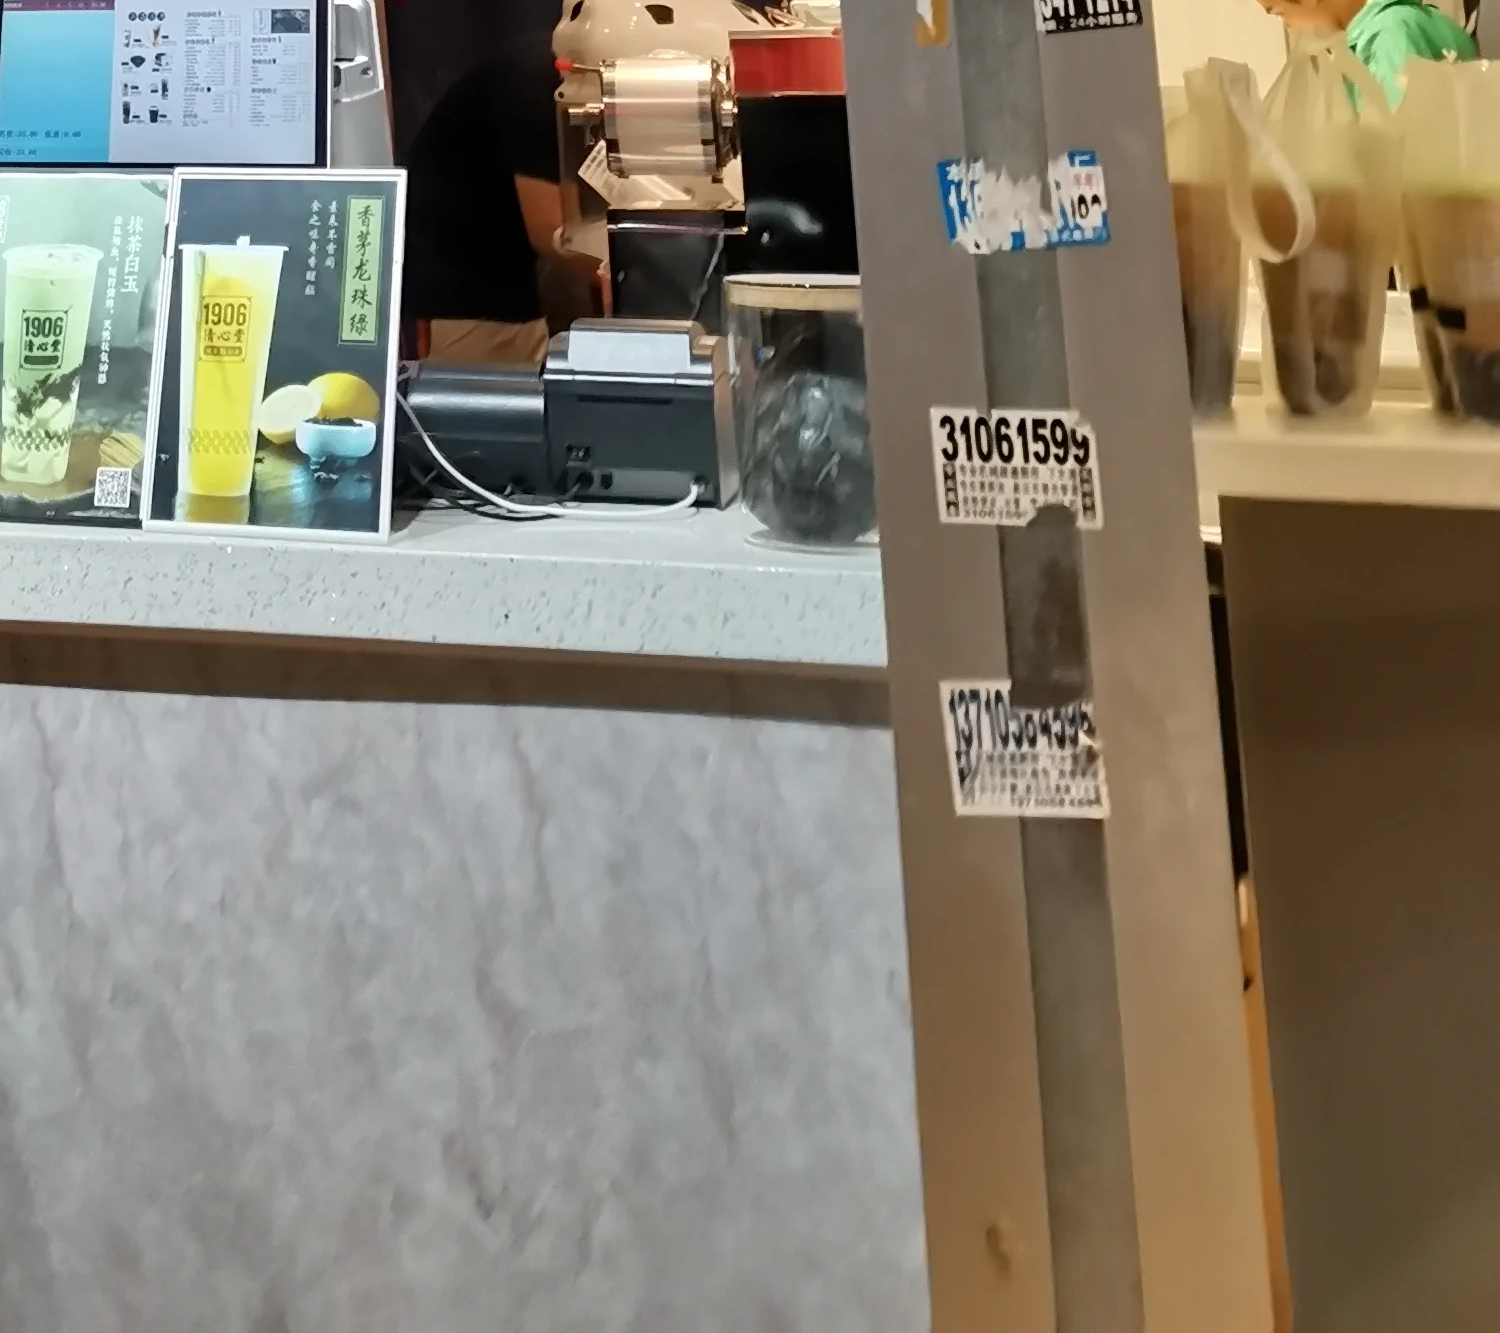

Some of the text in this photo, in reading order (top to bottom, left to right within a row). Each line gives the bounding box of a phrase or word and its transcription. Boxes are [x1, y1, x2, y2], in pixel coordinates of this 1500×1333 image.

[120, 215, 144, 293] 抹茶白玉
[349, 204, 375, 336] 香茅龙珠绿
[203, 302, 247, 326] 1906
[23, 316, 65, 338] 1906
[203, 327, 246, 343] 清心堂
[23, 338, 62, 353] 清心堂
[939, 415, 1090, 467] 31061599
